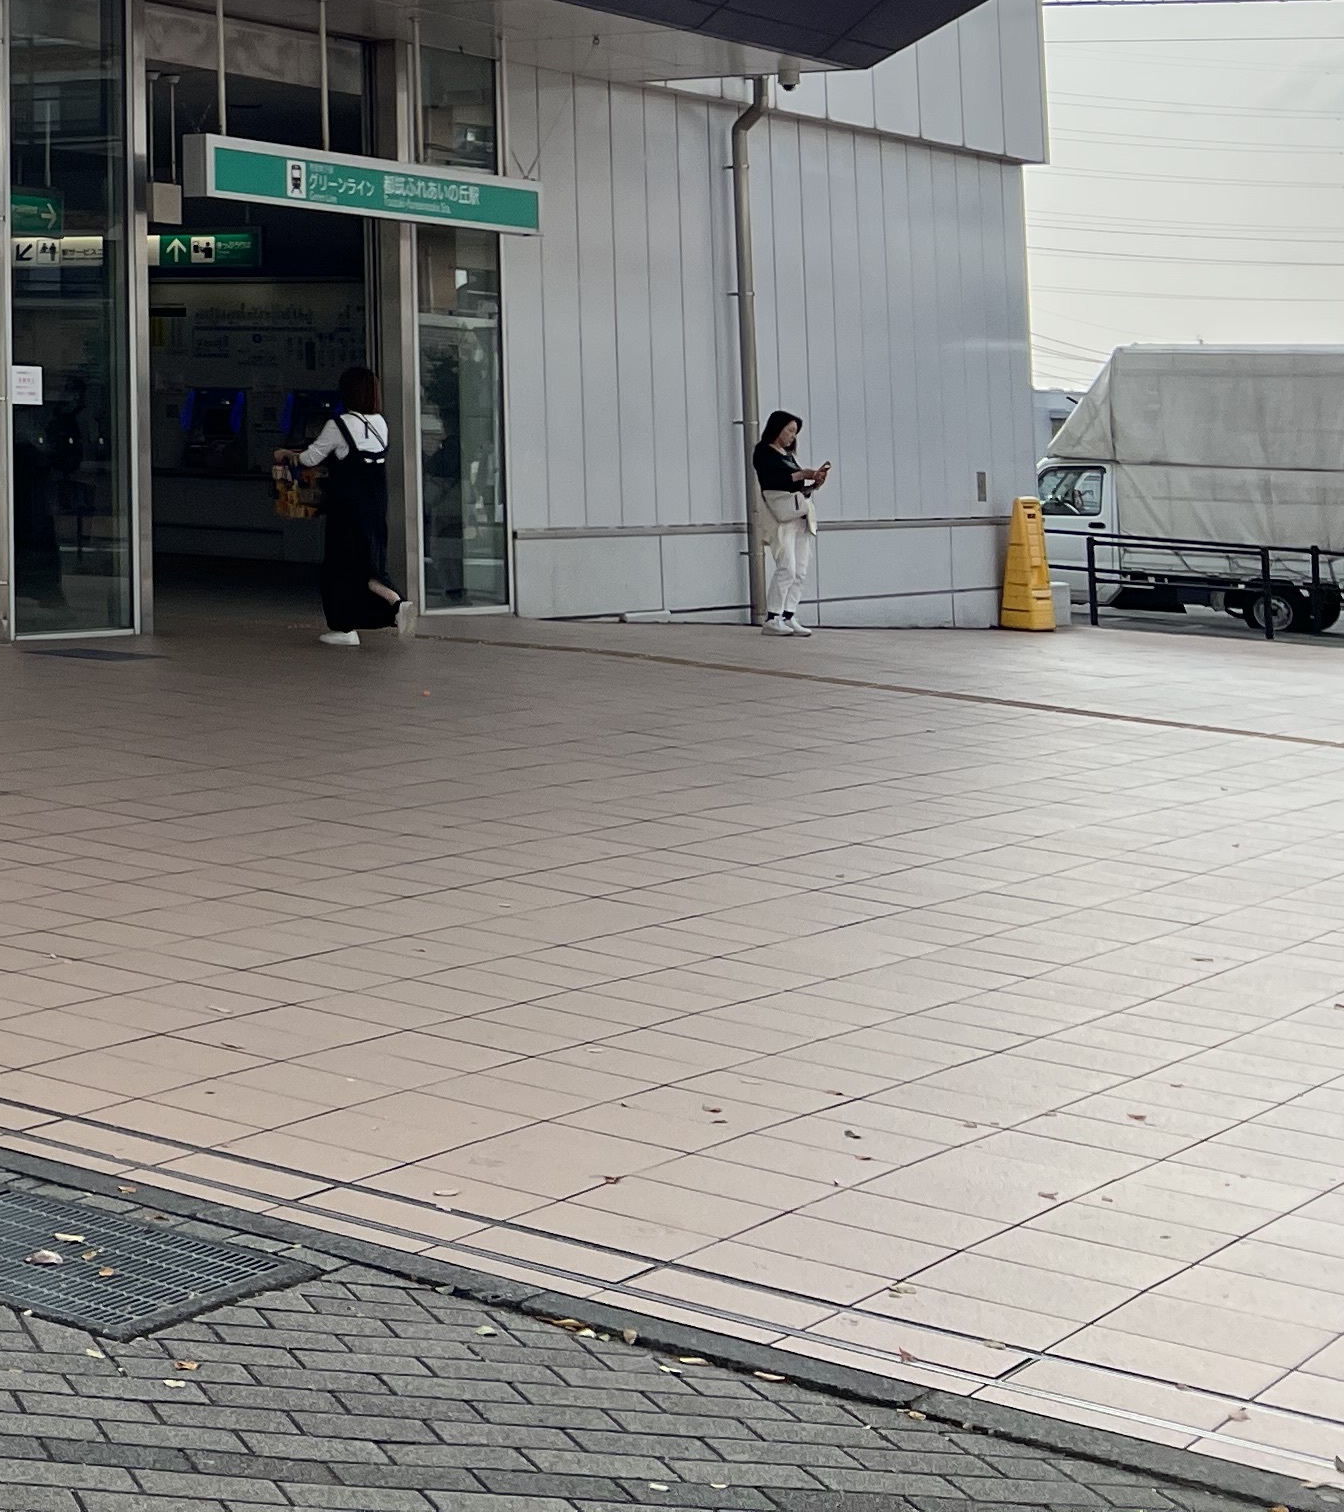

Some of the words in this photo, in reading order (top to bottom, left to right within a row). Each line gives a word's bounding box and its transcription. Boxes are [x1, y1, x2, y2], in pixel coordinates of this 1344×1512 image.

[308, 172, 375, 197] グリーンライン
